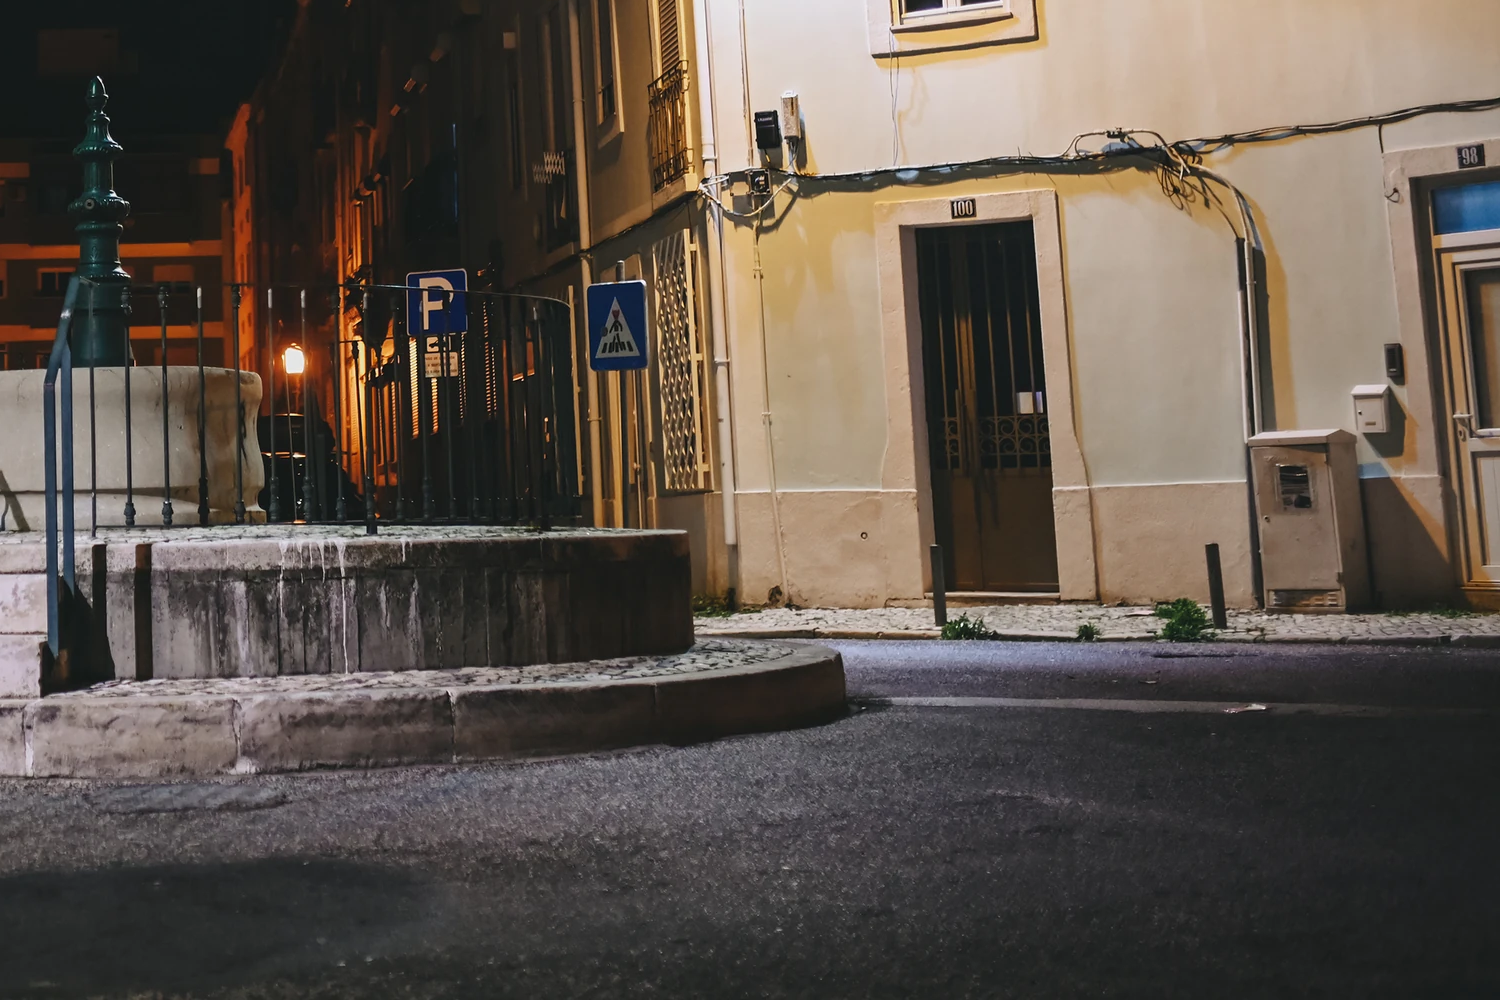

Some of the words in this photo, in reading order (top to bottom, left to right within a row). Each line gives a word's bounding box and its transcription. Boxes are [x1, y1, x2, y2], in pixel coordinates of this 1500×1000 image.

[1461, 146, 1479, 165] 98
[953, 200, 974, 217] 100
[418, 277, 455, 331] P
